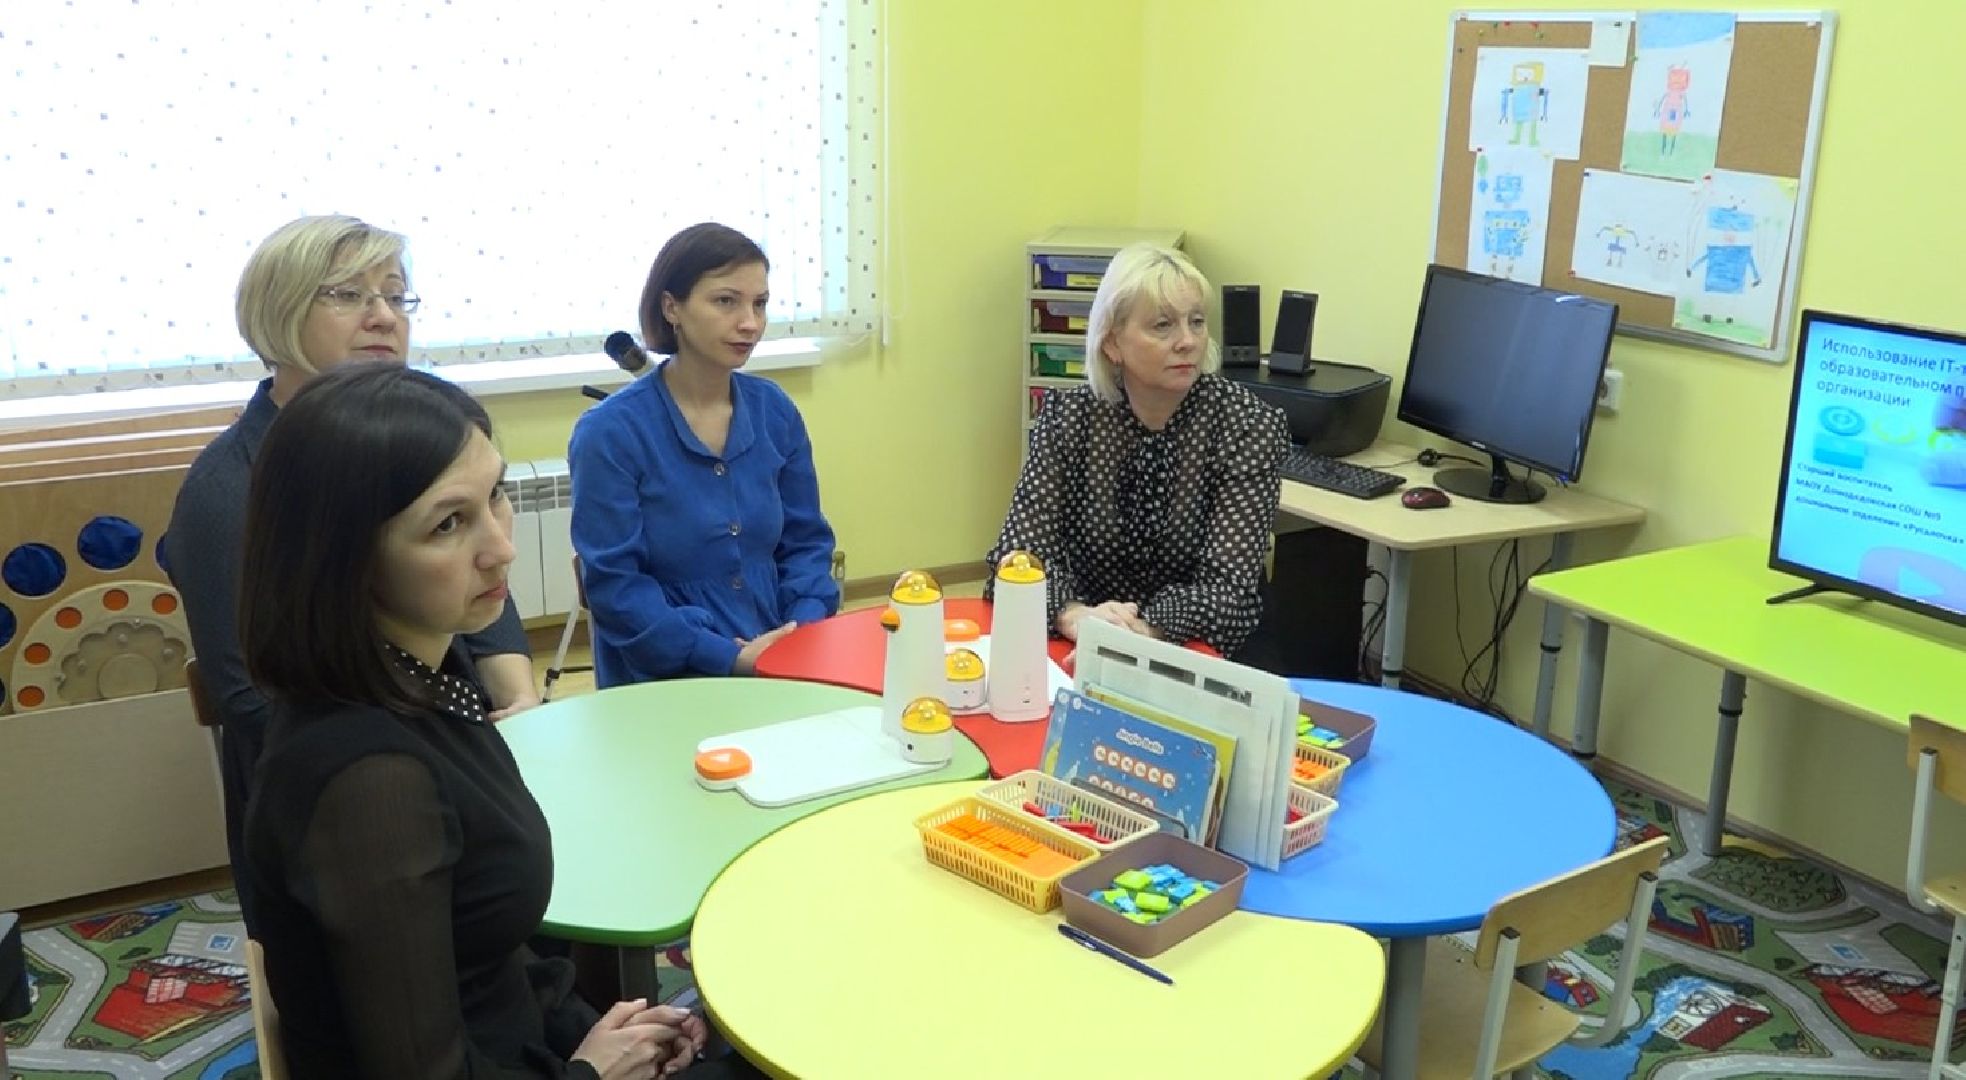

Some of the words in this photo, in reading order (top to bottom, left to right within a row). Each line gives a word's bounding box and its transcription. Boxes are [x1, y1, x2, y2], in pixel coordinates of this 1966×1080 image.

[1823, 338, 1937, 370] Использование
[1820, 359, 1953, 394] образовательном
[1817, 380, 1912, 407] организации
[1899, 503, 1922, 517] СОШ
